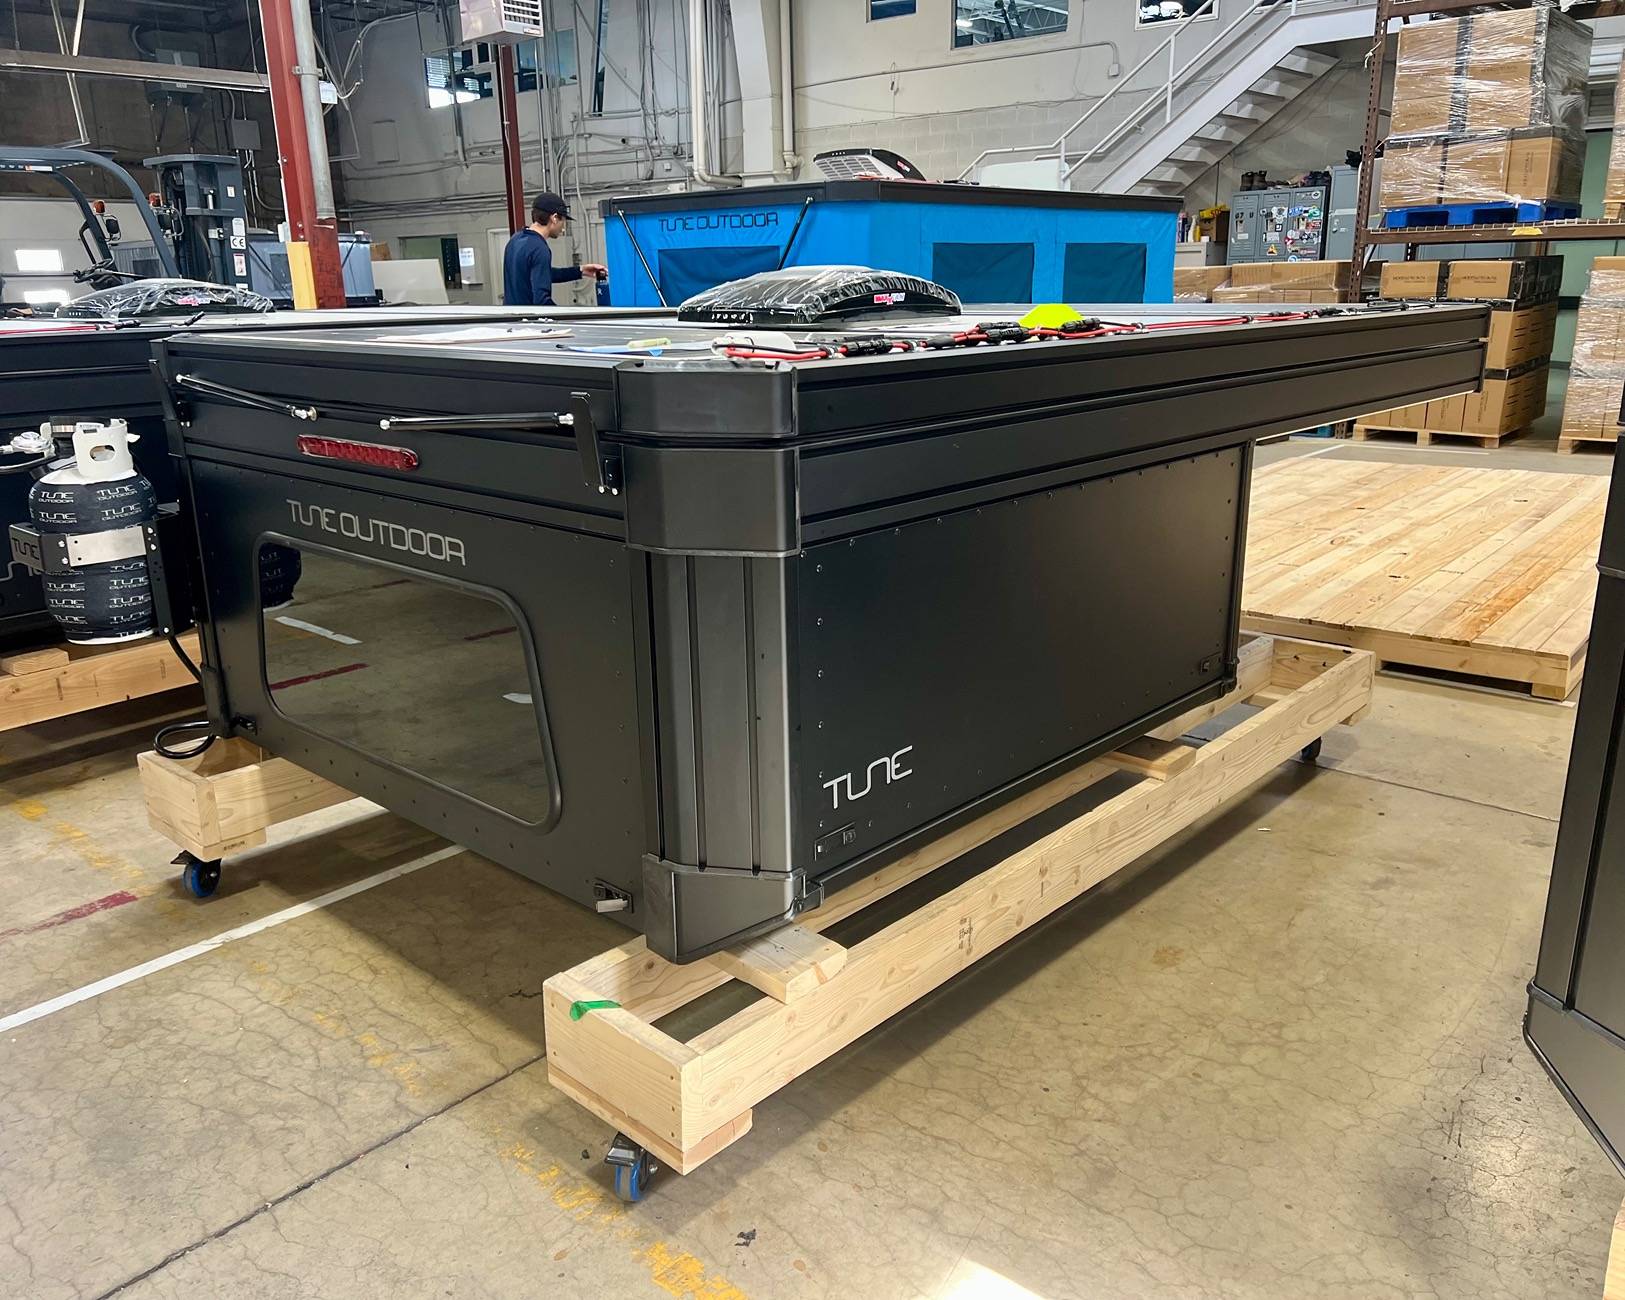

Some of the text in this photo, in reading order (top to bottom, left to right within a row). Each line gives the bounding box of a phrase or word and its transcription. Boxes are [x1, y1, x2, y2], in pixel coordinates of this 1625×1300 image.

[658, 212, 779, 232] TUNE OUTDOOR
[41, 491, 74, 500] TUNE
[96, 485, 136, 496] TUNE
[39, 512, 76, 520] TUNE
[101, 503, 141, 516] TUNE
[286, 499, 466, 566] TUNE OUTDOOR
[12, 537, 40, 560] TUNE
[54, 614, 86, 622] TUNE
[823, 745, 913, 809] TUNE
